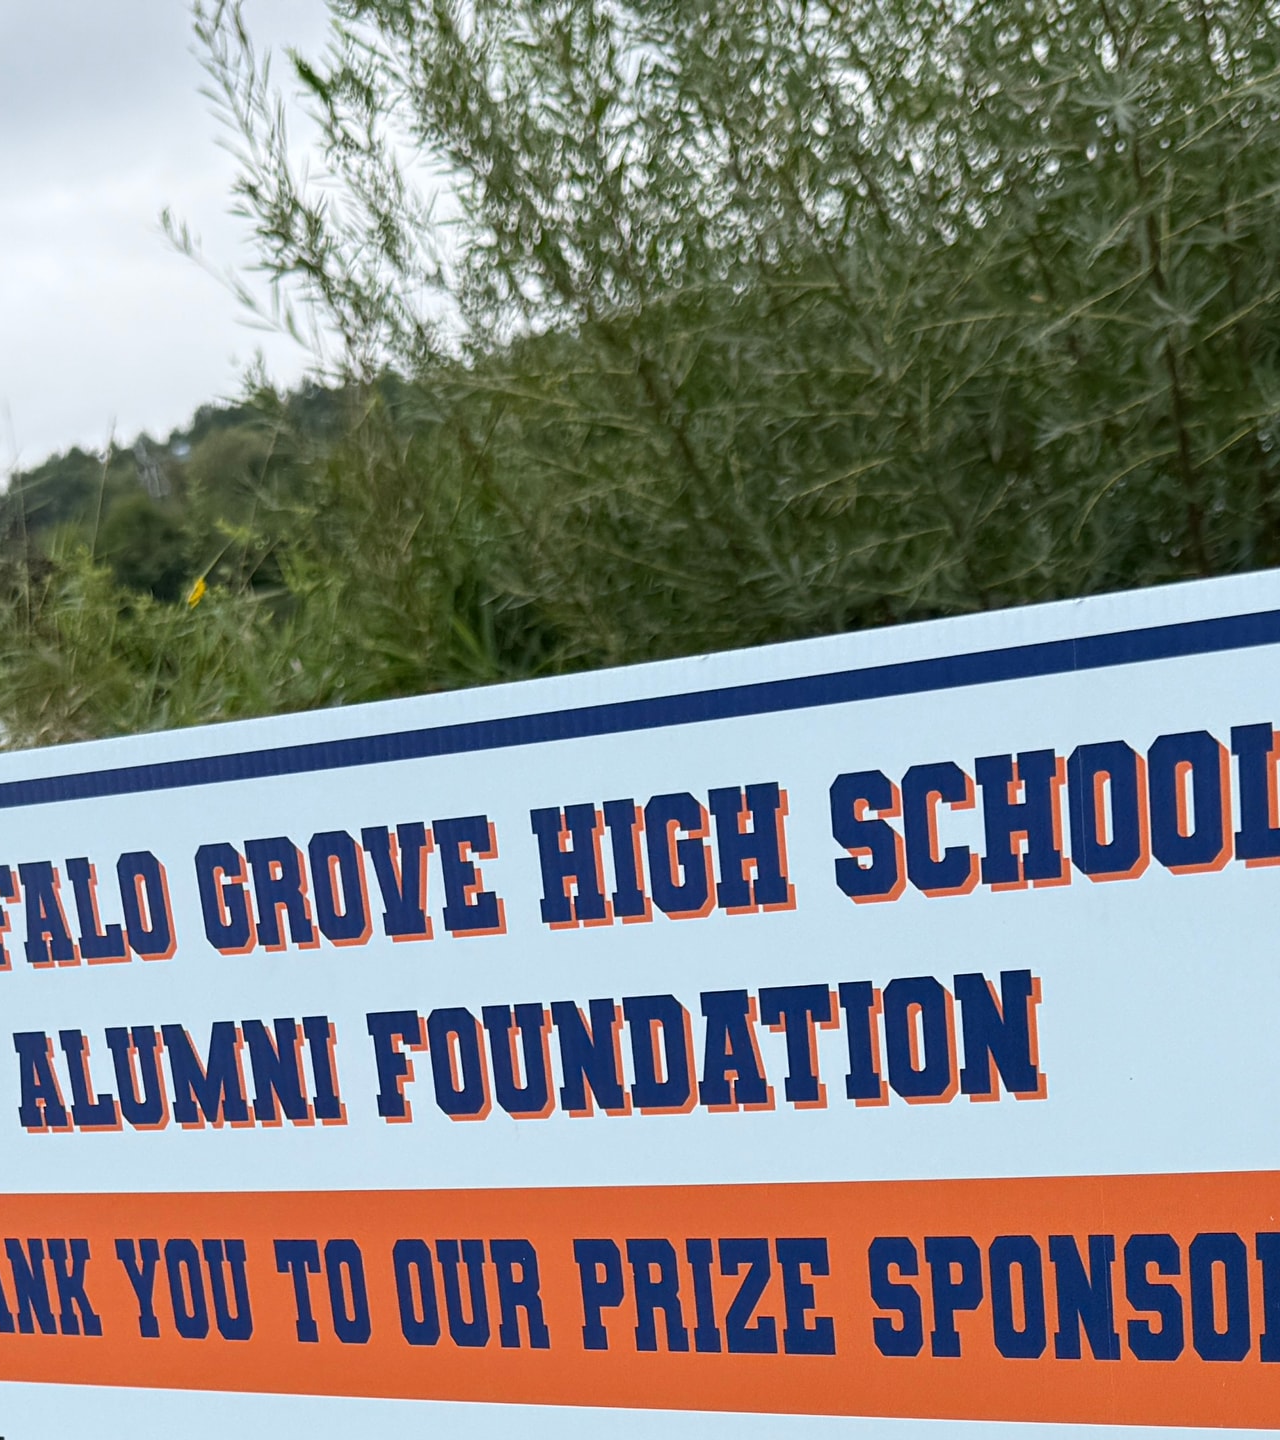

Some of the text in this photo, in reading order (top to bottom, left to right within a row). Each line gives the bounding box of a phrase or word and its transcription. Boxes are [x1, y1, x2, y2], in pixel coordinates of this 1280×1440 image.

[195, 815, 506, 955] GROVE
[530, 782, 796, 930] HIGH
[13, 969, 1047, 1133] ALUMNI FOUNDATION
[115, 1239, 253, 1340] YOU
[273, 1239, 371, 1344] TO
[393, 1239, 550, 1349] OUR
[573, 1238, 836, 1355] PRIZE
